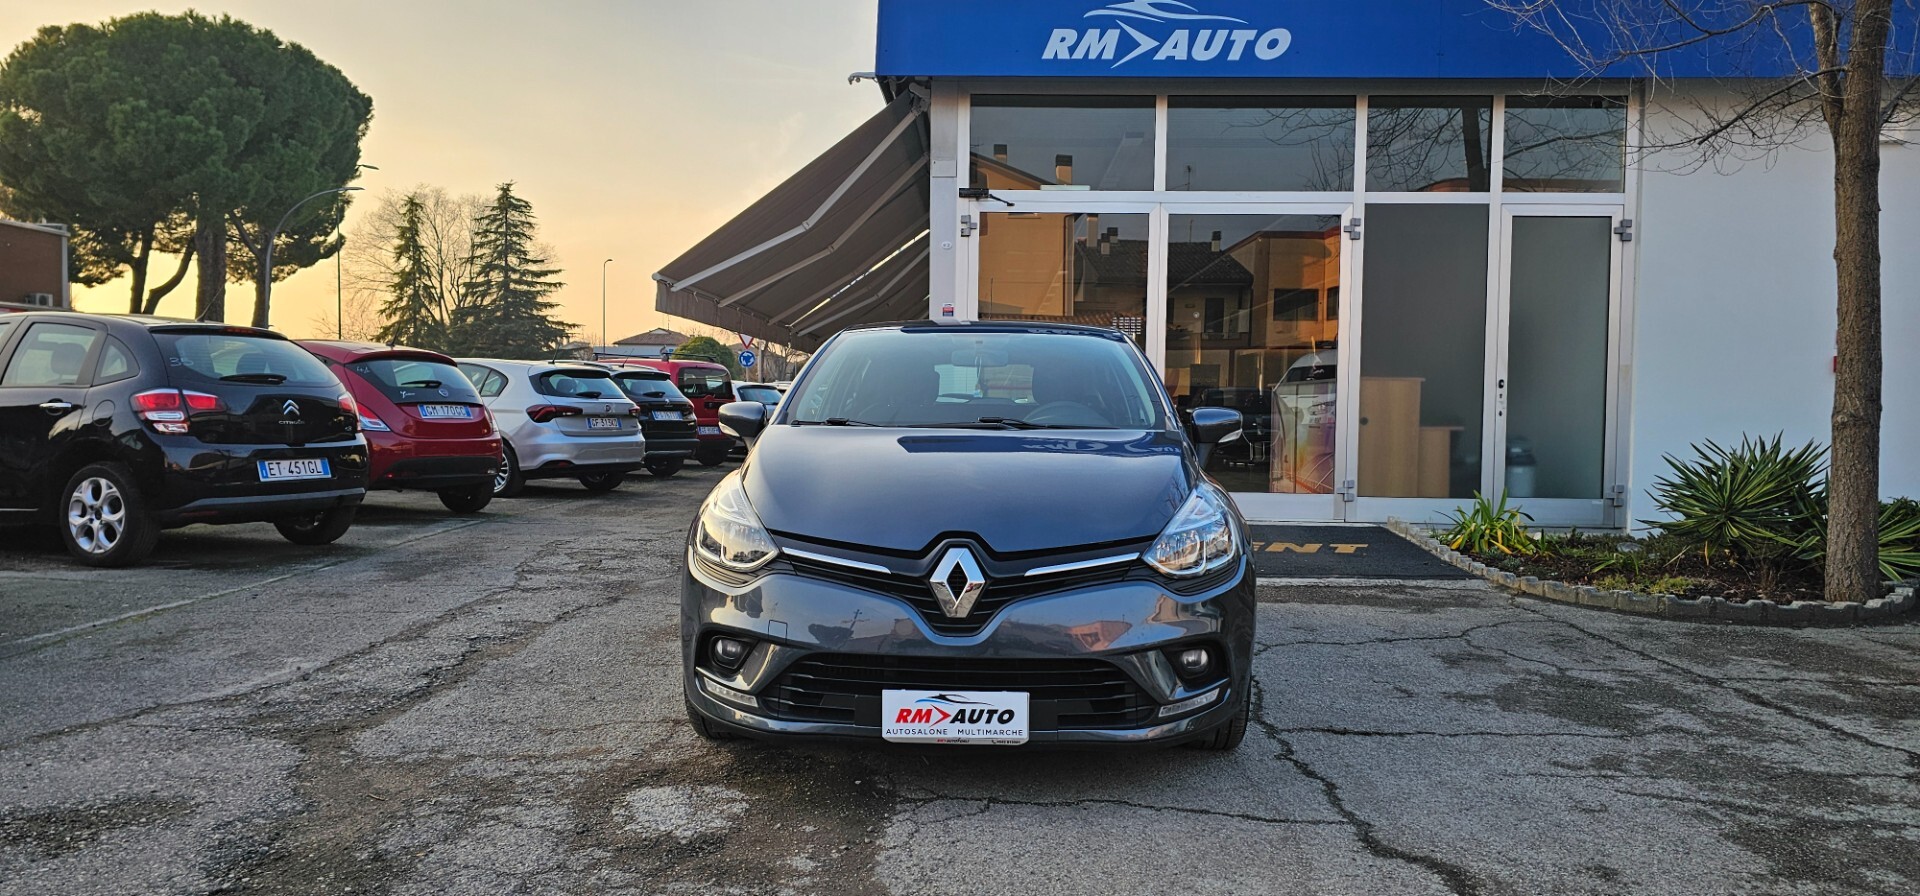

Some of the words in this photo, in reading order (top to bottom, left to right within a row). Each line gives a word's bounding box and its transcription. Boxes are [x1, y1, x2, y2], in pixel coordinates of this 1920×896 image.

[1153, 27, 1292, 62] AUTO
[267, 461, 282, 476] ET
[288, 460, 323, 475] 451GL
[949, 708, 1015, 725] AUTO
[885, 728, 948, 736] AUTOSALONE
[957, 728, 1024, 737] MULTIMARCHE
